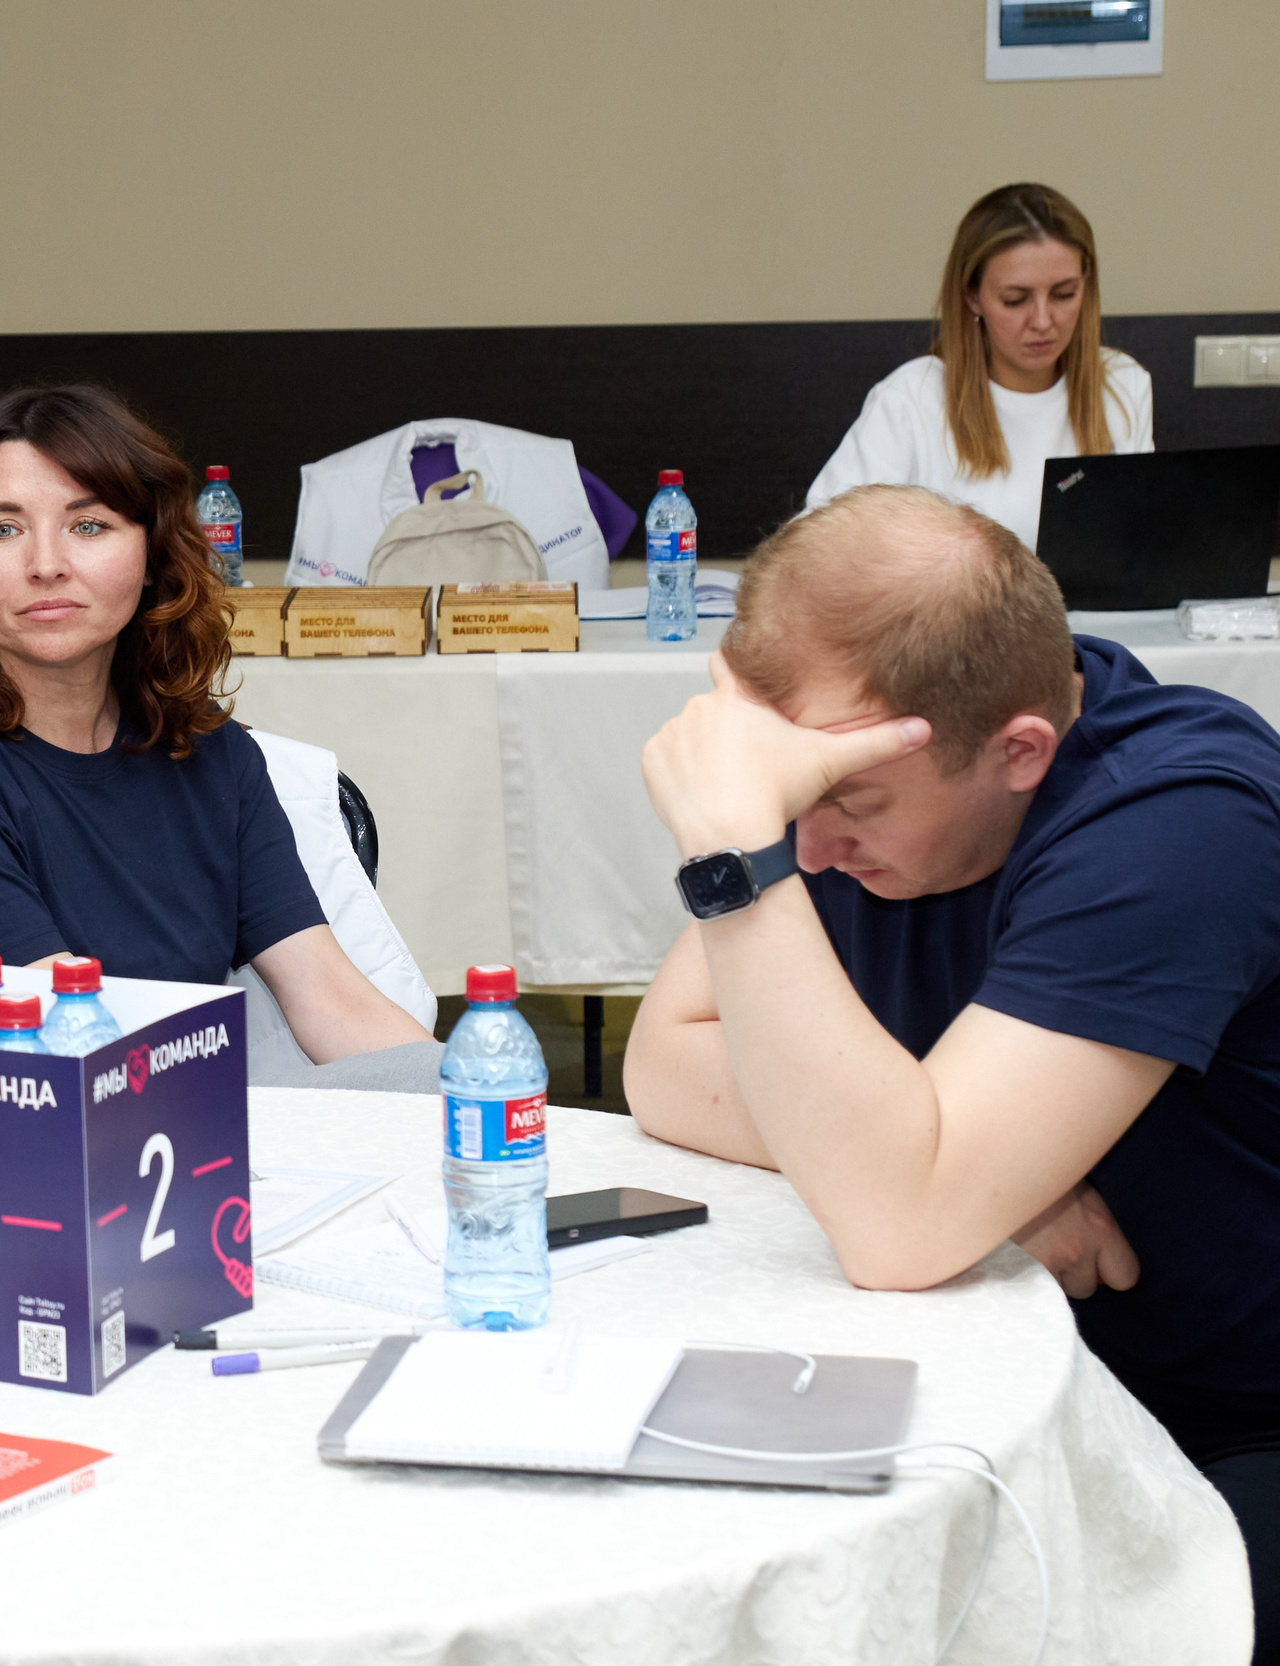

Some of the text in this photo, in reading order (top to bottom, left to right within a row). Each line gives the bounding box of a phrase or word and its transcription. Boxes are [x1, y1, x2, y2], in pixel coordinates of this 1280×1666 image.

[300, 617, 355, 627] МЕСТО ДЛЯ
[452, 614, 509, 624] МЕСТО ДЛЯ
[300, 629, 396, 638] ВАШЕГО ТЕЛЕФОНА
[452, 625, 549, 635] ВАШЕГО ТЕЛЕФОНА
[93, 1023, 230, 1104] #МЫ КОМАНДА
[138, 1132, 176, 1263] 2
